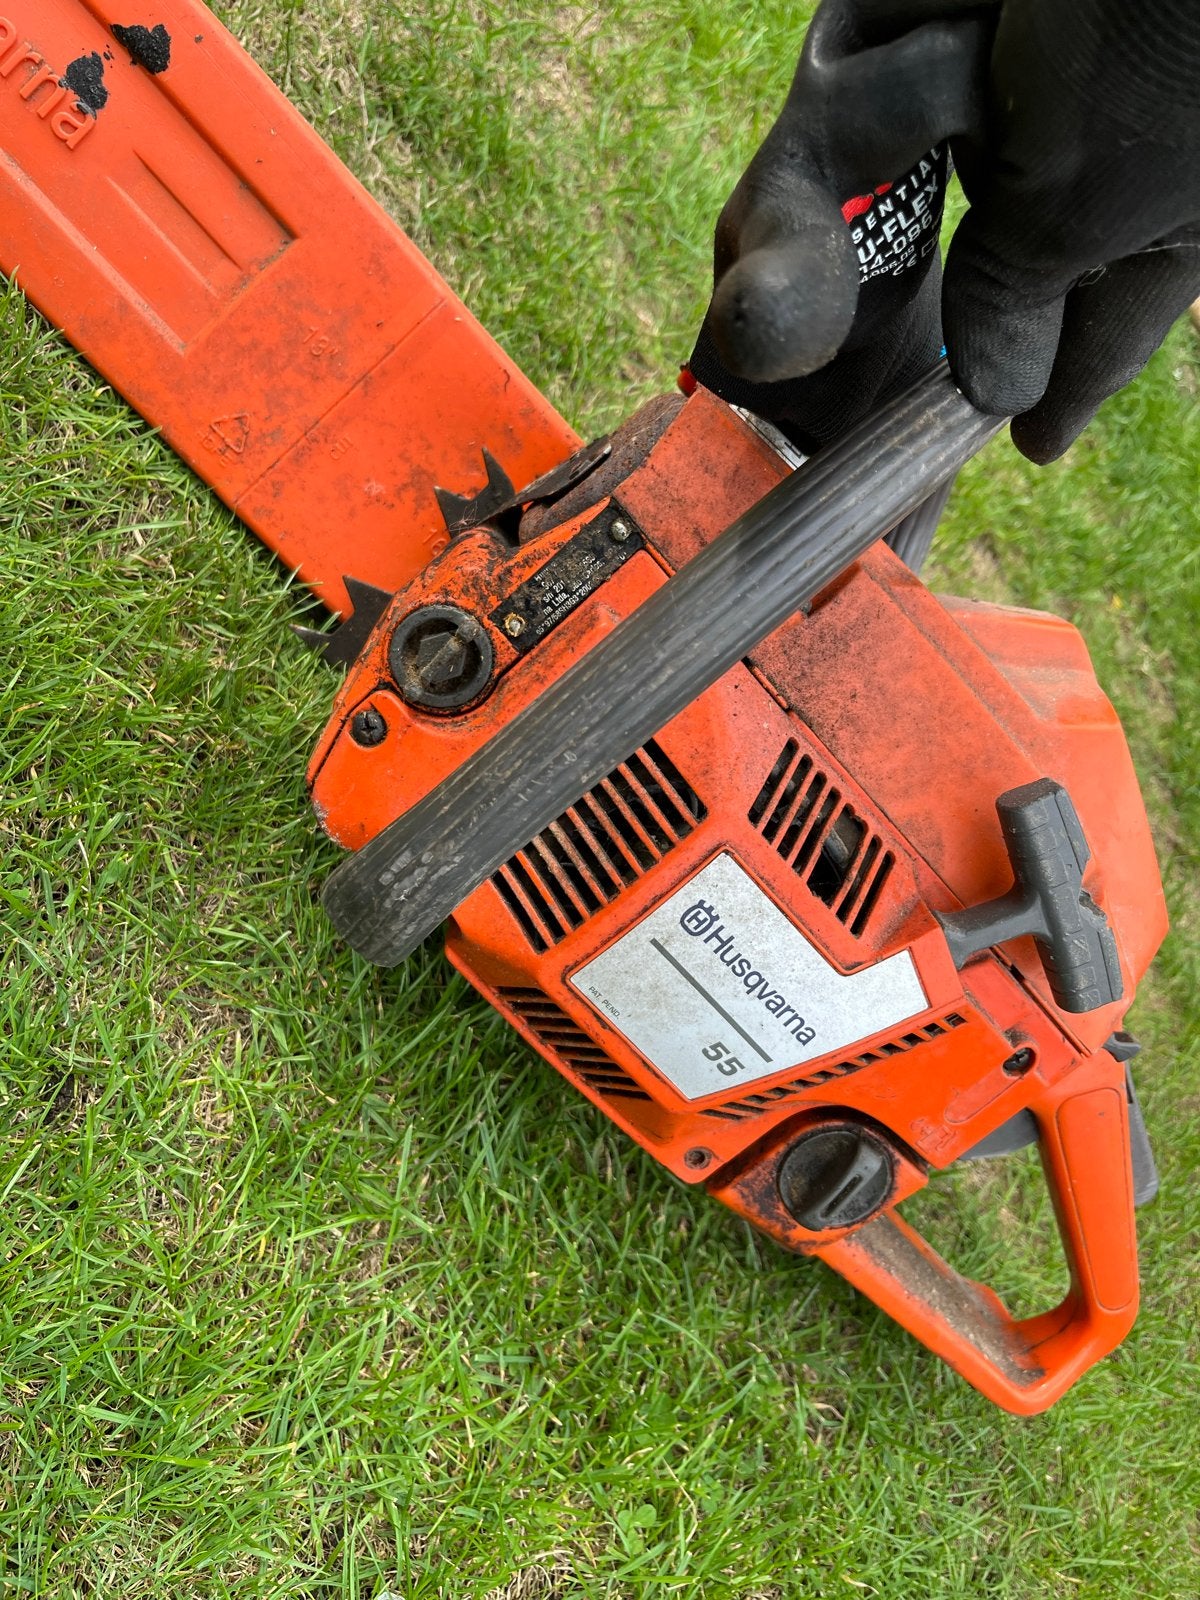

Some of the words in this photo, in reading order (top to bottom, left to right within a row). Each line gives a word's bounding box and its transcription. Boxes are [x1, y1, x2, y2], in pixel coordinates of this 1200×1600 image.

[702, 924, 817, 1047] Husqvarna
[601, 999, 621, 1020] PEND.
[701, 1041, 746, 1077] 55
